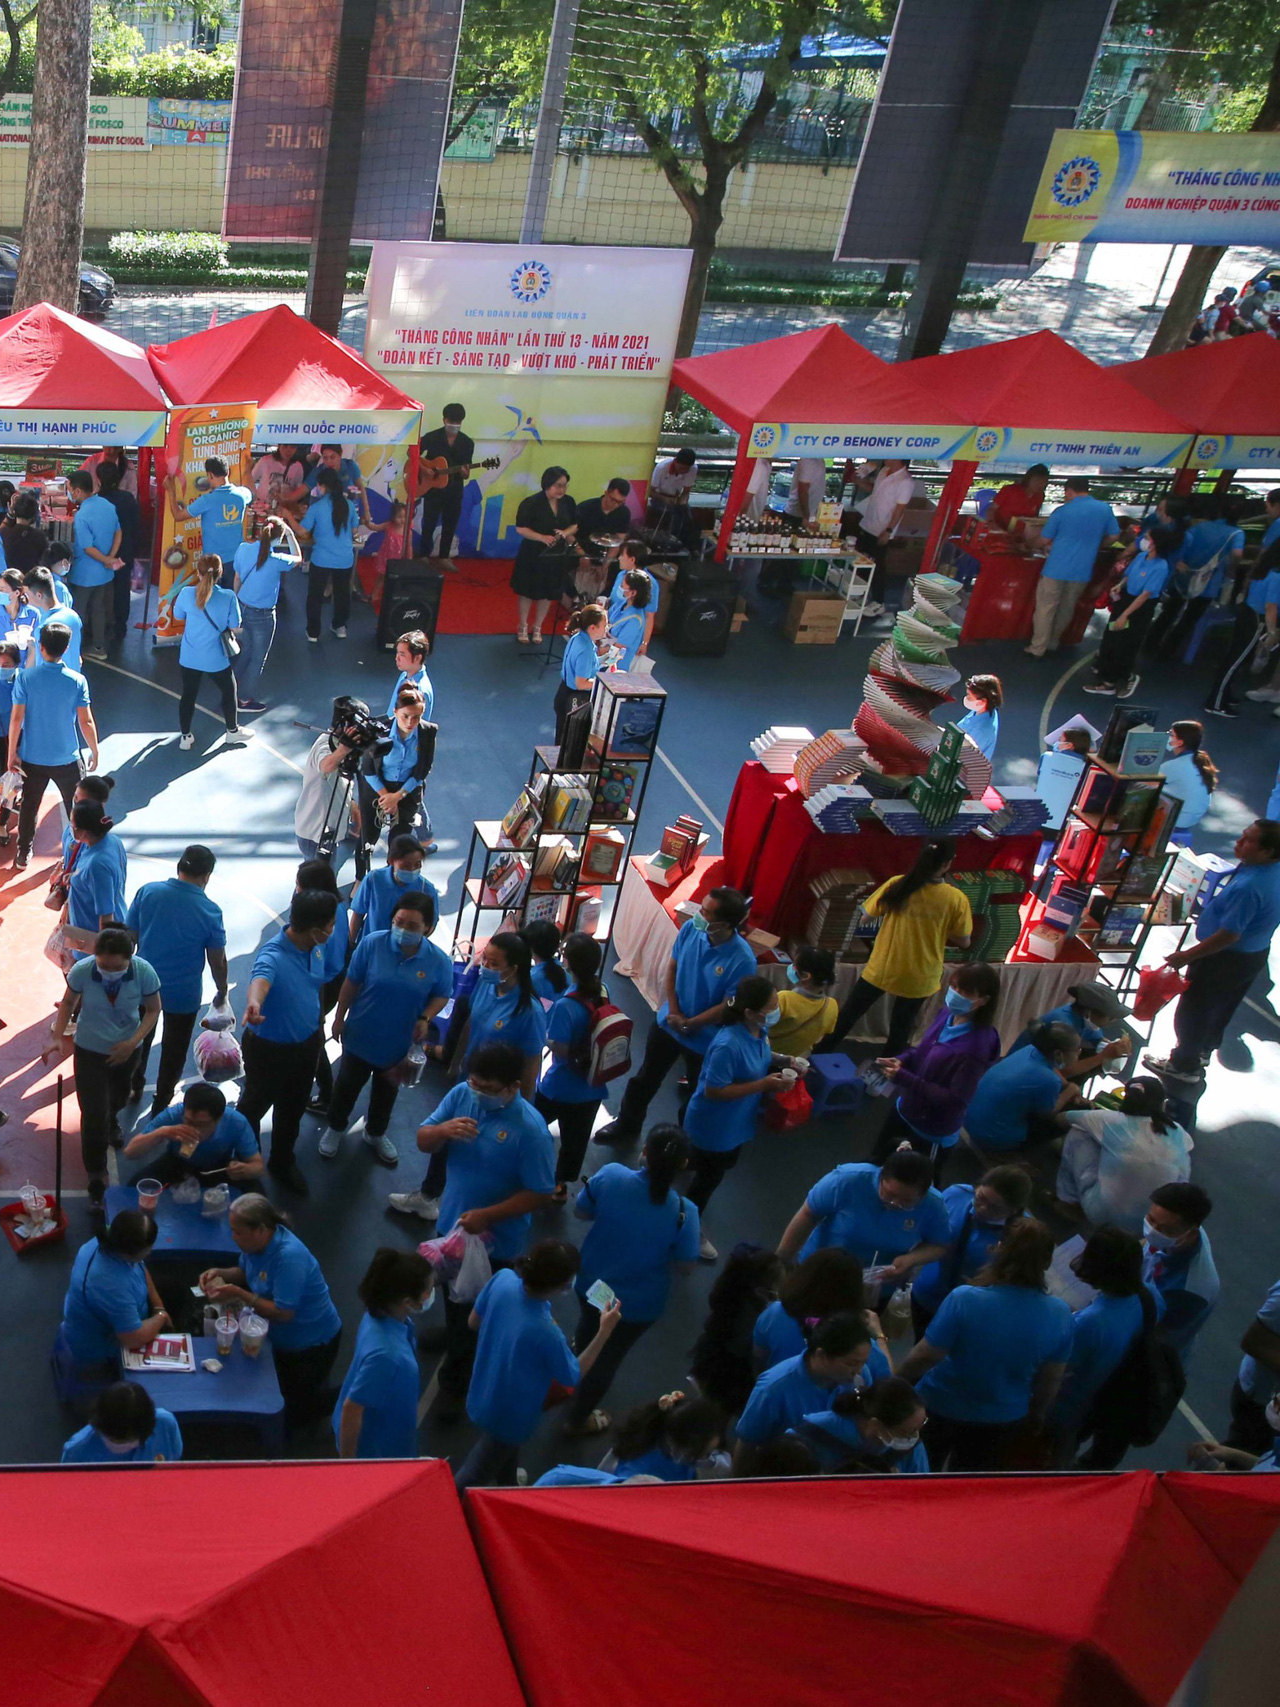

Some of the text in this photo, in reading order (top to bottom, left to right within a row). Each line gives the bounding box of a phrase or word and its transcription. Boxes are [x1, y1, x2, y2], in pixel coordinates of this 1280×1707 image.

[116, 136, 144, 146] SCHOOL
[1223, 168, 1259, 186] CÔNG
[1125, 197, 1163, 209] DOANH
[1165, 195, 1207, 213] NGHIỆP
[1208, 196, 1239, 213] QUẬN
[1241, 199, 1250, 210] 3
[442, 328, 473, 345] CÔNG
[476, 329, 514, 346] NHÂN"
[545, 330, 566, 348] THỨ
[570, 334, 581, 348] 13
[592, 332, 619, 349] NĂM
[622, 335, 649, 349] 2021
[419, 347, 442, 365] KẾT
[452, 350, 484, 367] SÁNG
[488, 353, 510, 369] TẠO
[521, 352, 551, 371] VƯỢT
[554, 352, 577, 369] KHÓ
[587, 353, 617, 369] PHÁT
[17, 422, 37, 435] THỊ
[42, 423, 77, 436] HẠNH
[82, 421, 116, 433] PHÚC
[187, 426, 206, 437] LAN
[208, 419, 249, 435] PHƯƠNG
[269, 424, 299, 434] TNHH
[303, 420, 335, 434] QUỐC
[339, 424, 379, 434] PHONG
[193, 430, 240, 446] ORGANIC
[793, 435, 941, 448] CTY CP BEHONEY CORP
[1029, 442, 1141, 456] CTY TNHH THIÊN AN
[1248, 447, 1275, 458] CTY
